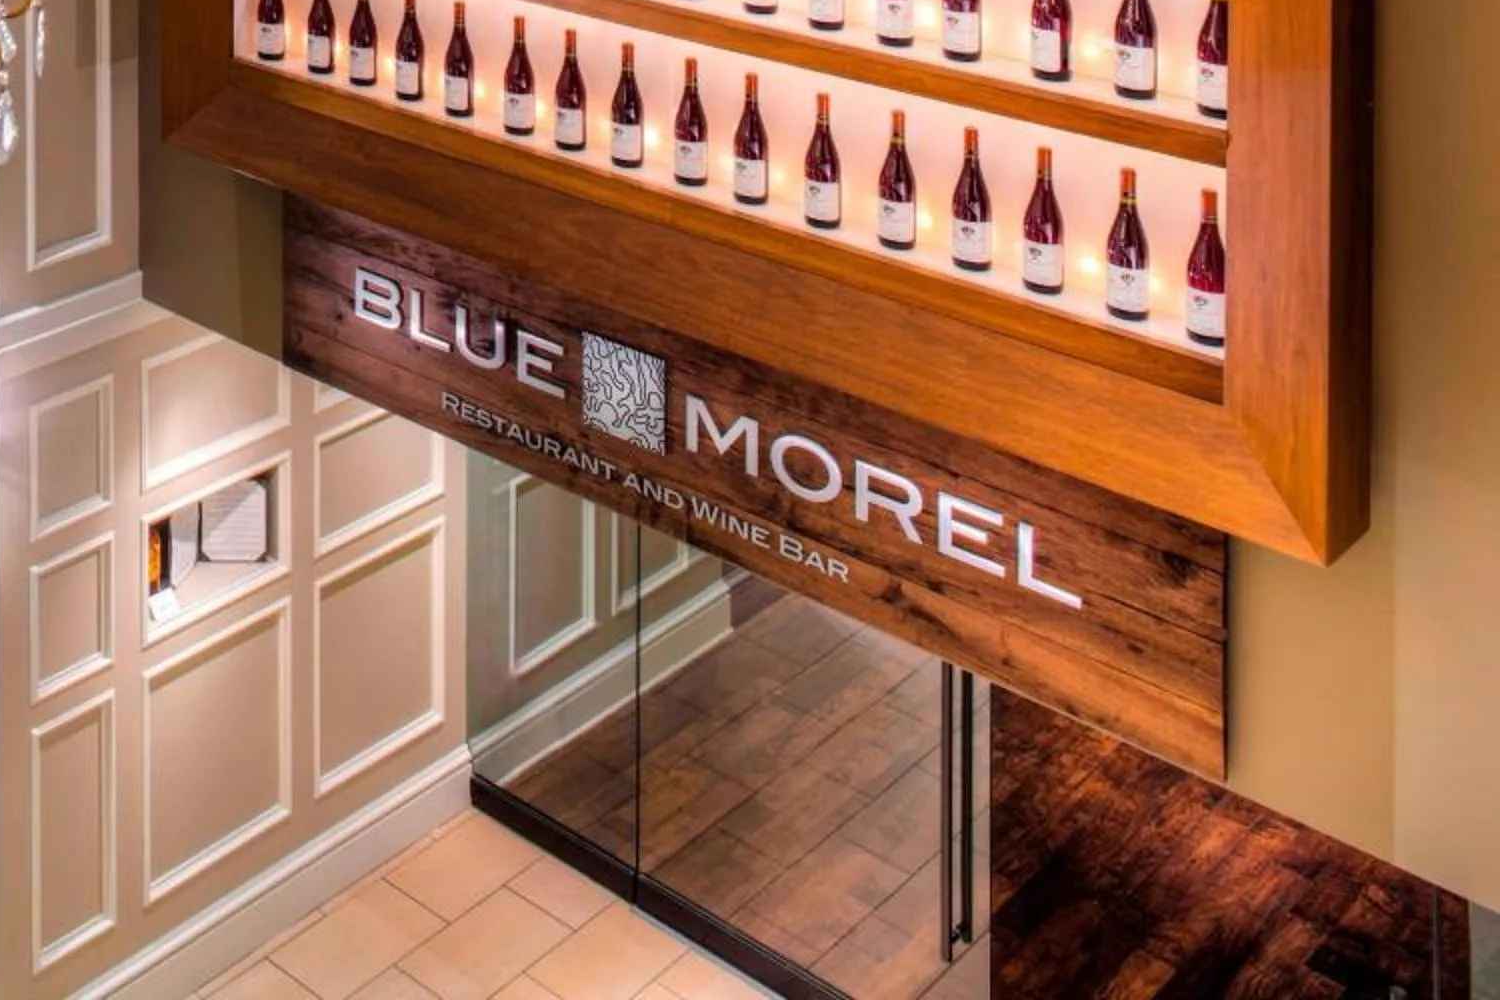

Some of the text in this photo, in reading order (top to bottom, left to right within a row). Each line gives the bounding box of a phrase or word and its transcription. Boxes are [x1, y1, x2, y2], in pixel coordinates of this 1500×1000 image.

[355, 267, 1083, 611] BLUE MOREL
[442, 391, 850, 584] RESTAURANT AND WINE BAR
